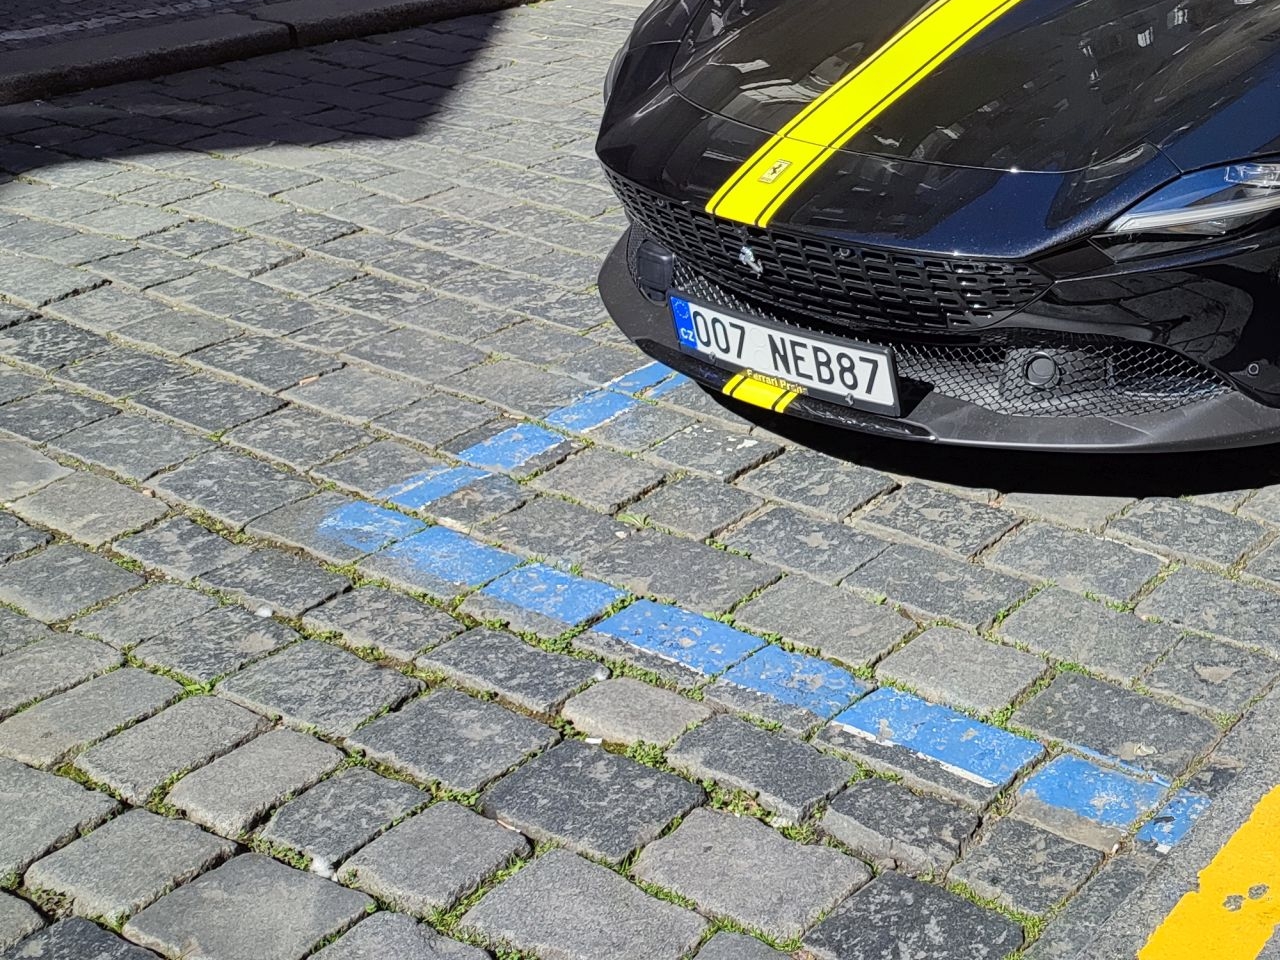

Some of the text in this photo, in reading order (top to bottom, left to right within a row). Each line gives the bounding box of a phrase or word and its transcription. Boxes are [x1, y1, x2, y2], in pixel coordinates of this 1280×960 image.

[680, 327, 697, 342] CZ
[767, 334, 879, 394] NEB87
[746, 368, 779, 387] Ferrari
